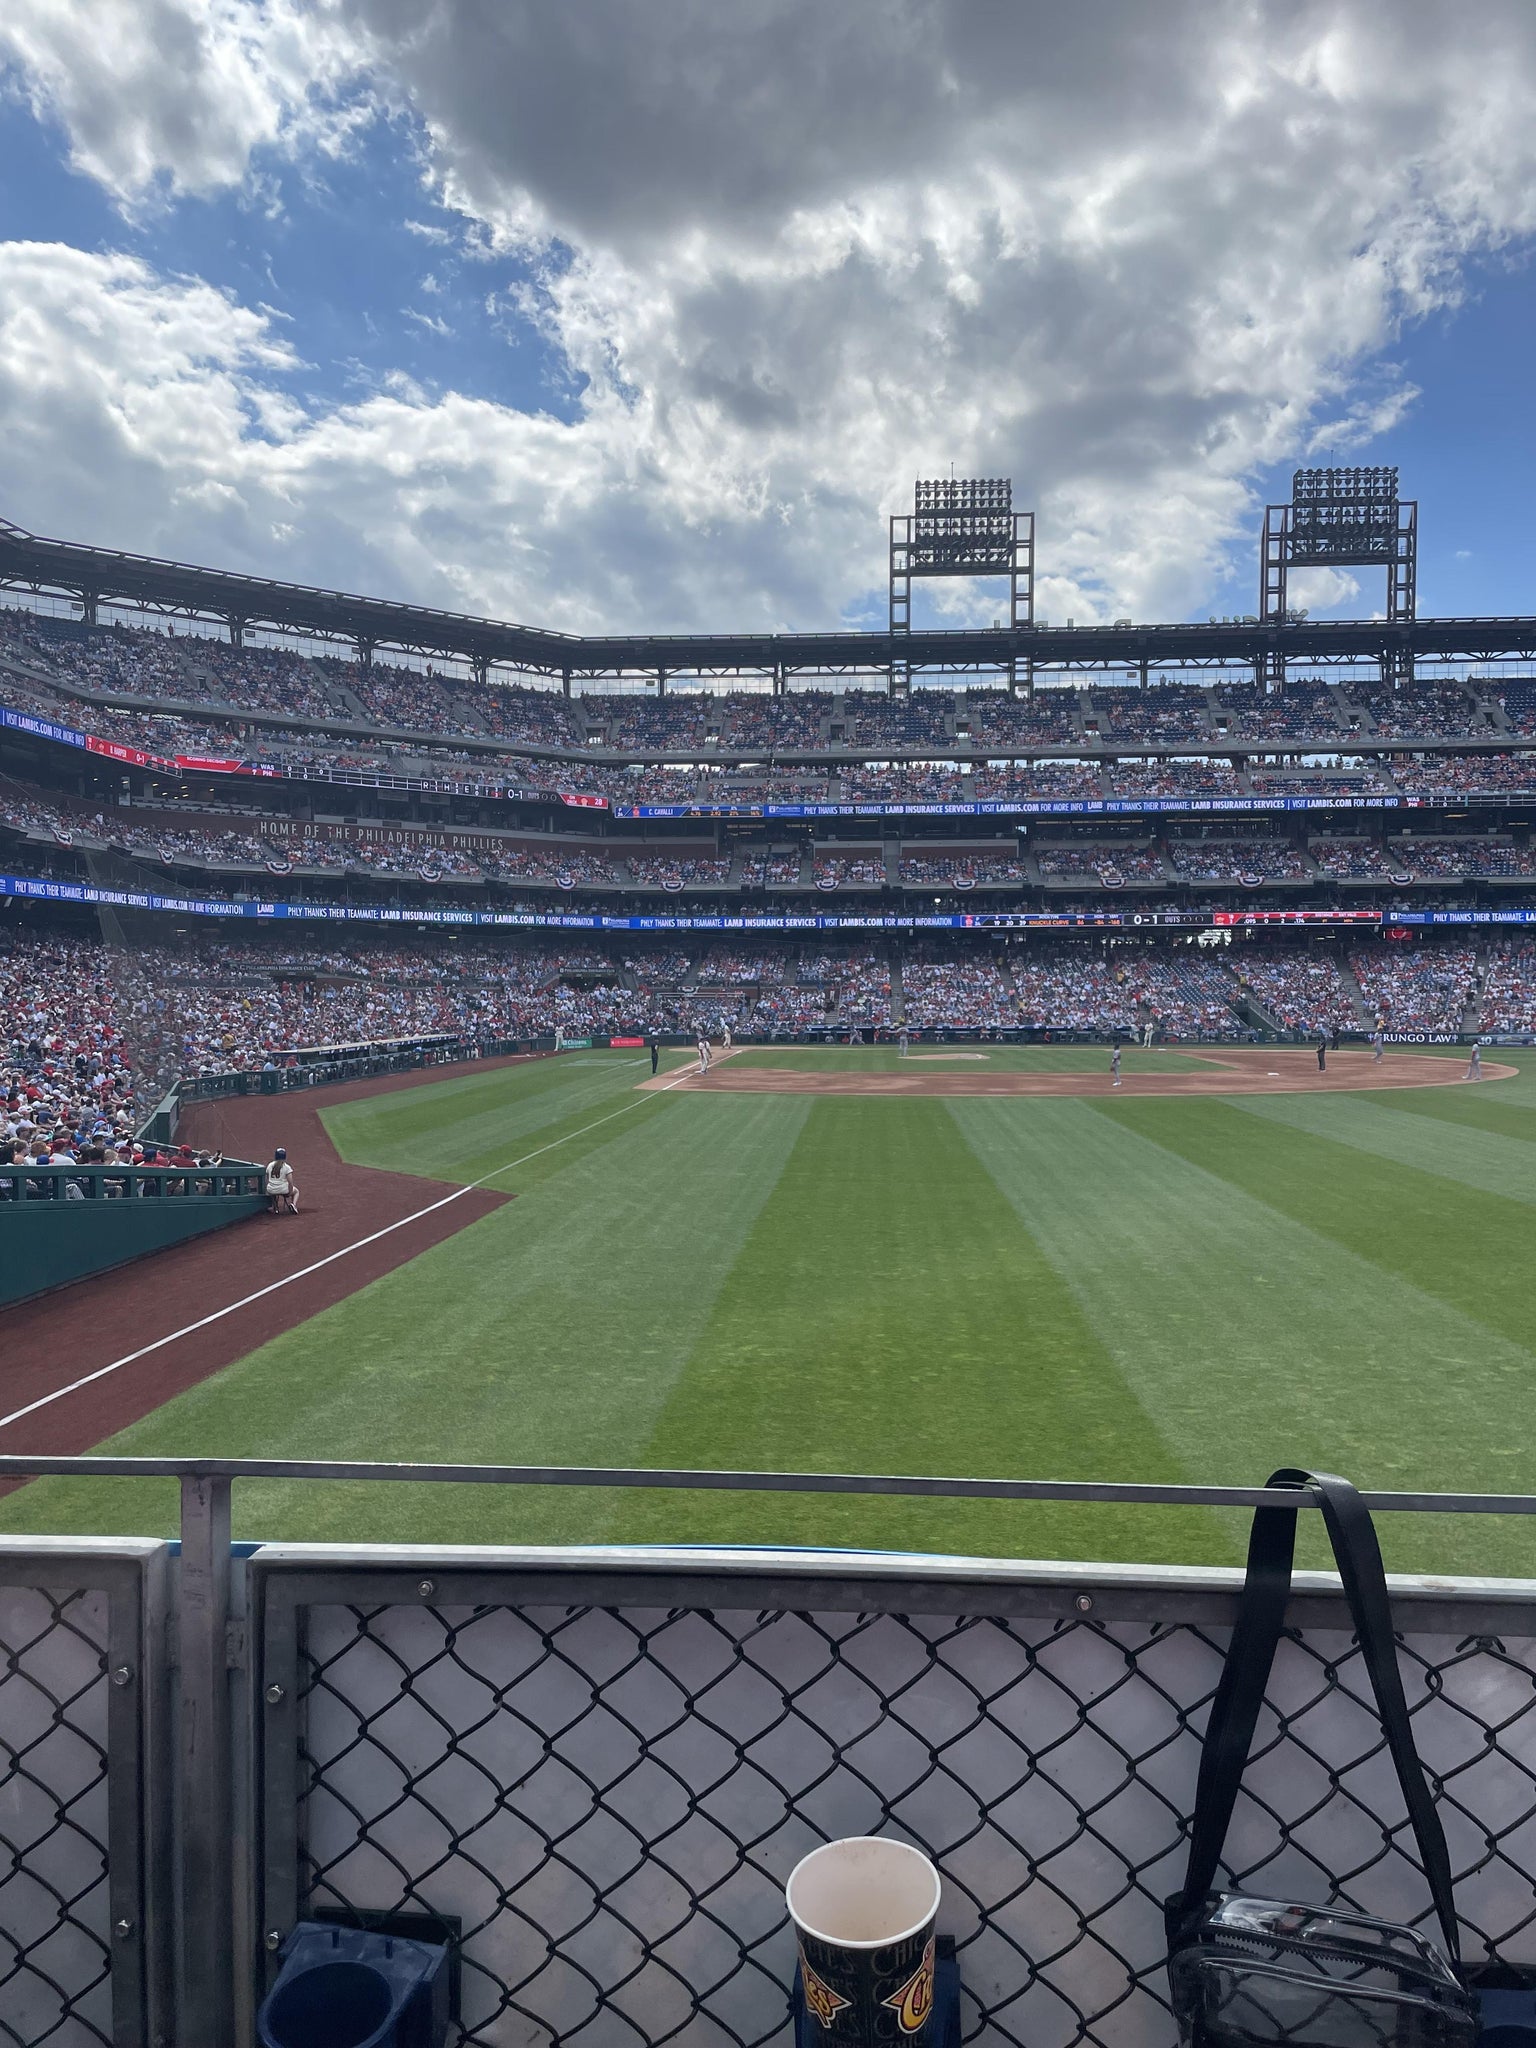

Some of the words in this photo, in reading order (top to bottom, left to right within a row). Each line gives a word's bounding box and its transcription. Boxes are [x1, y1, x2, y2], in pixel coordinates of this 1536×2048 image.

[6, 712, 18, 725] VISIT
[19, 716, 52, 737] LAMBIS.COM
[54, 727, 62, 739] FOR
[63, 729, 75, 744] MORE
[75, 732, 84, 746] INFO
[508, 789, 523, 799] 0-1
[818, 807, 838, 815] THANKS
[885, 806, 904, 814] LAMB
[906, 805, 943, 813] INSURANCE
[945, 805, 975, 813] SERVICES
[982, 804, 995, 812] VISIT
[996, 804, 1039, 812] LAMBIS.COM
[1041, 803, 1051, 811] FOR
[1053, 803, 1069, 811] MORE
[1071, 802, 1084, 811] INFO
[1088, 801, 1103, 809] LAMB
[1107, 803, 1120, 811] PHLY
[1122, 802, 1142, 810] THANKS
[1143, 802, 1159, 810] THEIR
[1192, 801, 1211, 809] LAMB
[1212, 800, 1252, 809] INSURANCE
[1254, 800, 1285, 809] SERVICES
[1293, 800, 1306, 808] VISIT
[1308, 799, 1352, 808] LAMBIS.COM
[1354, 799, 1365, 807] FOR
[1366, 799, 1383, 807] MORE
[1385, 798, 1398, 807] INFO
[261, 822, 296, 835] HOME
[305, 824, 319, 838] OF
[328, 826, 350, 839] THE
[358, 829, 446, 845] PHILADELPHIA
[453, 836, 503, 850] PHILLIES
[84, 888, 99, 901] LAMB
[128, 894, 148, 906] SERVICES
[257, 904, 274, 913] LAMB
[288, 906, 303, 916] PHLY
[304, 907, 327, 918] THANKS
[329, 908, 345, 918] THEIR
[381, 910, 400, 920] LAMB
[402, 911, 441, 921] INSURANCE
[443, 912, 473, 922] SERVICES
[480, 914, 493, 923] VISIT
[495, 914, 535, 924] LAMBIS.COM
[536, 915, 546, 924] FOR
[547, 916, 562, 925] MORE
[1433, 914, 1448, 922] PHLY
[1450, 914, 1472, 922] THANKS
[1473, 913, 1491, 921] THEIR
[641, 919, 653, 927] PHLY
[655, 919, 676, 927] THANKS
[677, 919, 692, 927] THEIR
[724, 918, 743, 927] LAMB
[745, 918, 784, 927] INSURANCE
[785, 918, 816, 927] SERVICES
[824, 918, 838, 926] VISIT
[839, 918, 883, 927] LAMBIS.COM
[884, 917, 896, 926] FOR
[897, 917, 914, 926] MORE
[915, 917, 953, 926] INFORMATION
[1383, 1033, 1425, 1043] RUNGO
[1429, 1034, 1452, 1042] LAW
